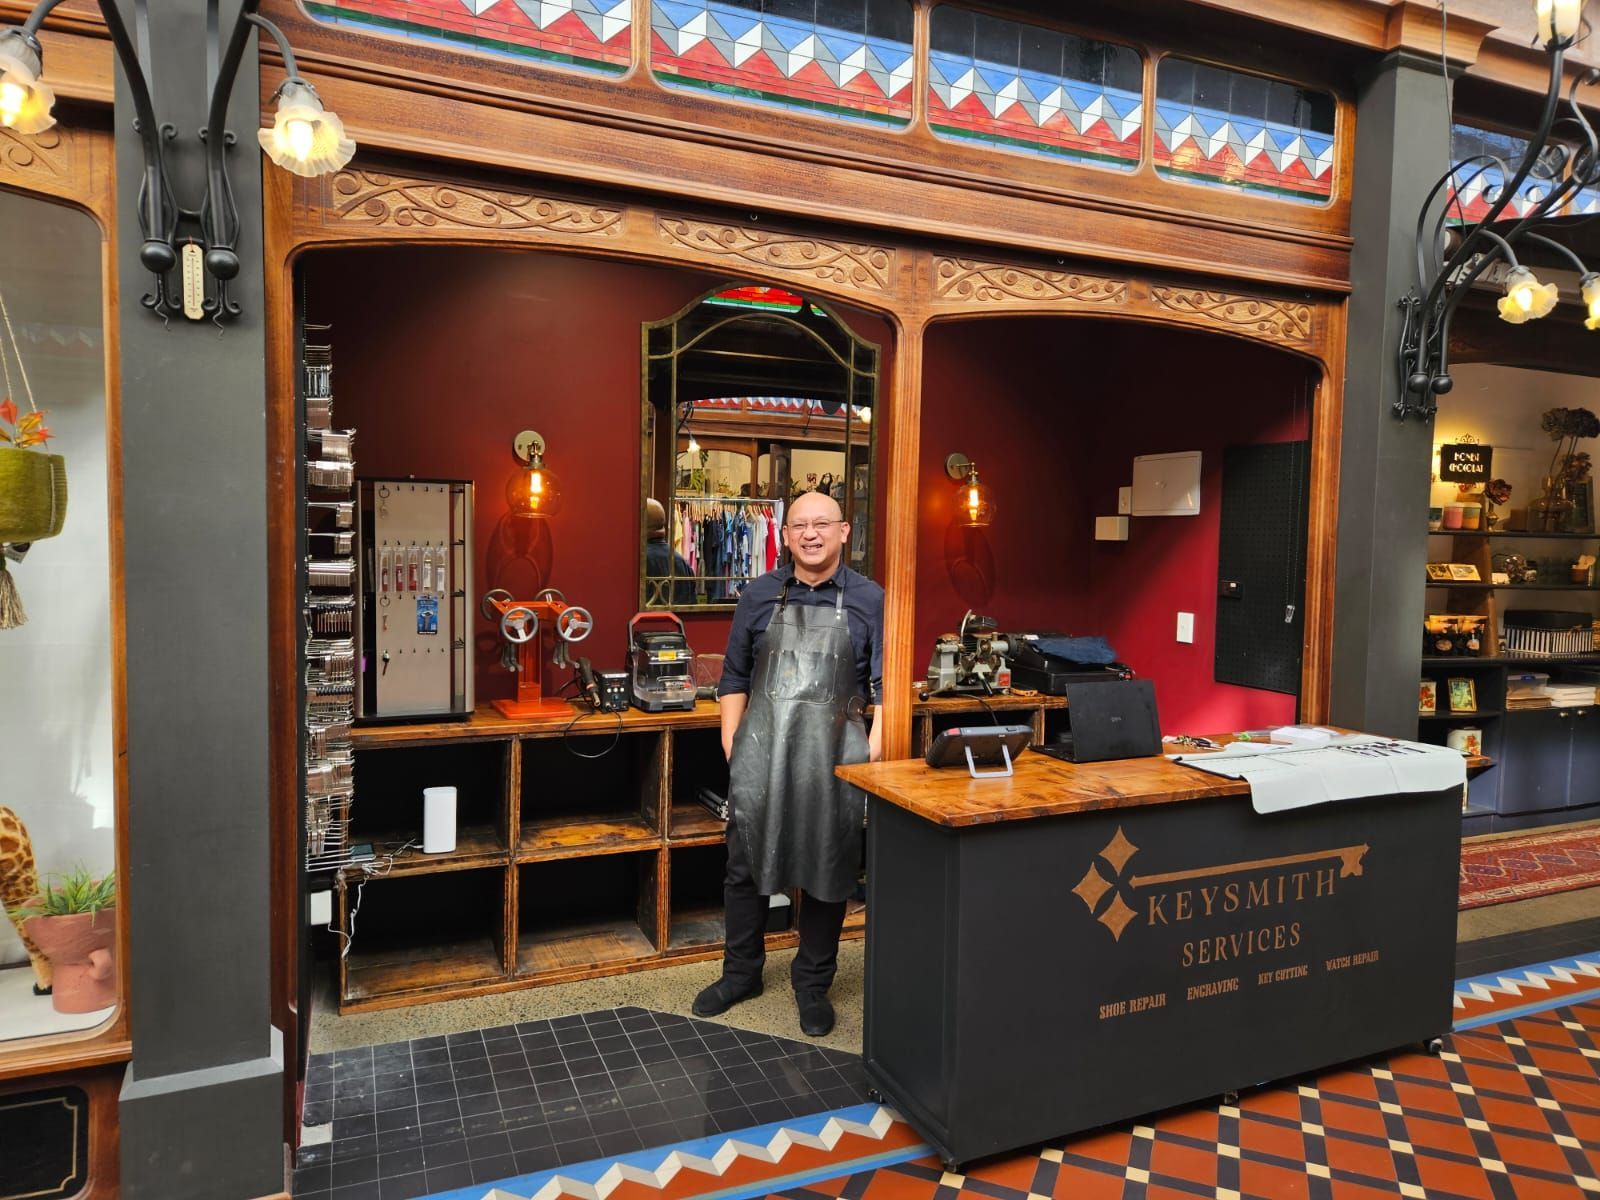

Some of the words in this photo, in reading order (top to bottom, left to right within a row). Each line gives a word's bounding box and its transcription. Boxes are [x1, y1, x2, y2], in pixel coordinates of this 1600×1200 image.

[1147, 868, 1335, 926] KEYSMITH
[1182, 922, 1301, 967] SERVICES
[1326, 955, 1351, 971] WATCH
[1352, 950, 1379, 966] REPAIR
[1258, 971, 1274, 985] KEY
[1275, 965, 1309, 982] CUTTING
[1187, 977, 1239, 1001] ENGRAVING
[1099, 1001, 1127, 1020] SHOE
[1129, 993, 1167, 1013] REPAIR
